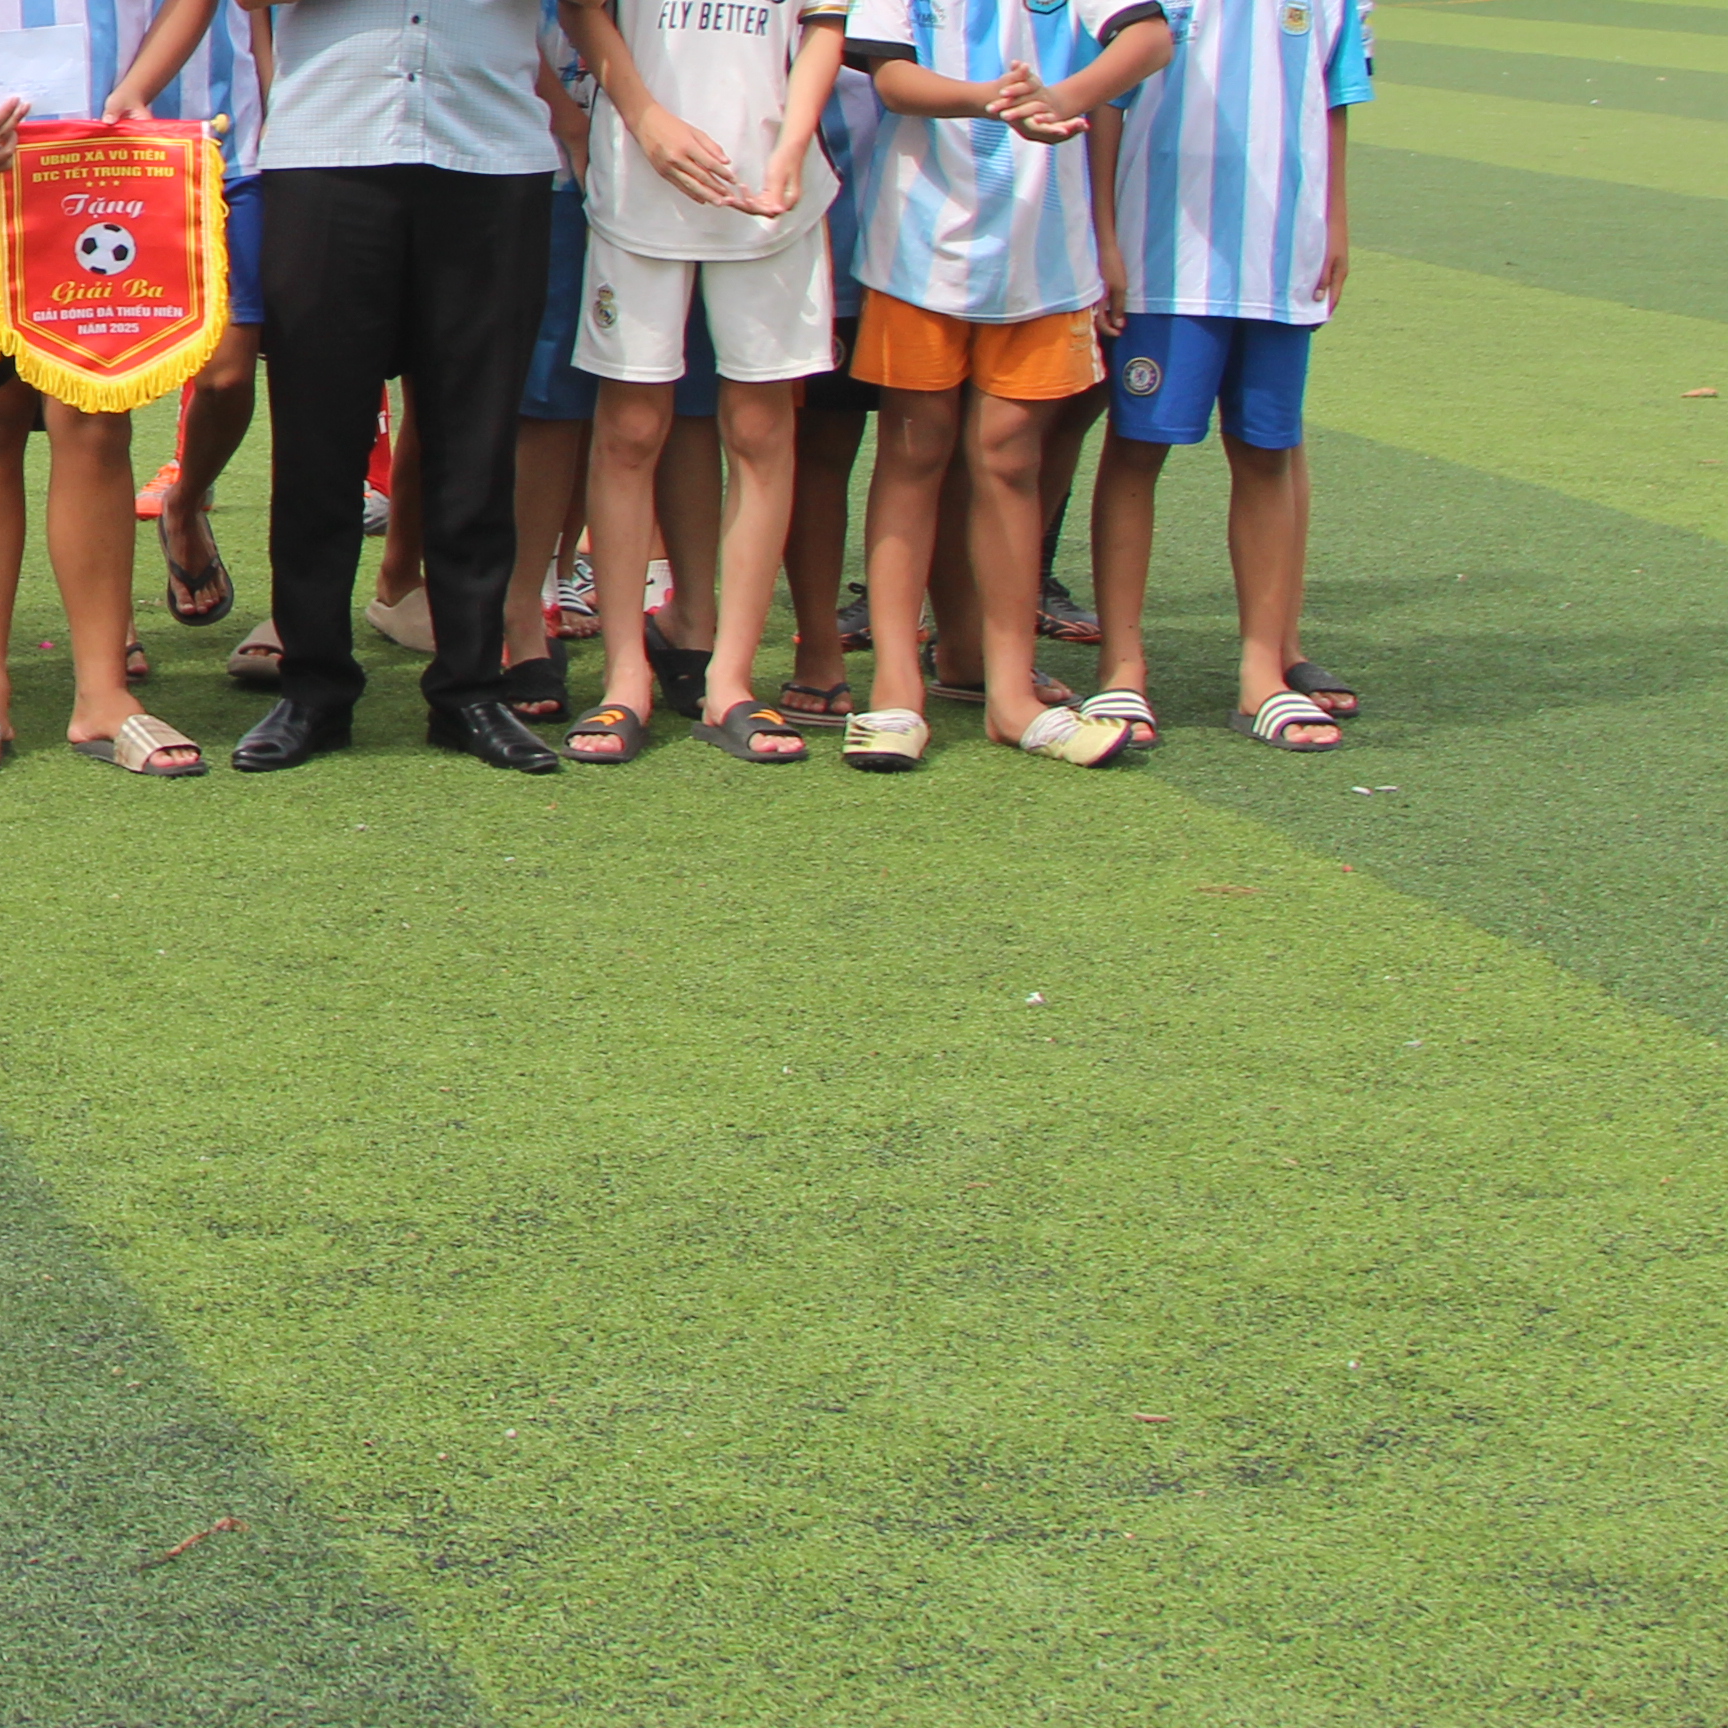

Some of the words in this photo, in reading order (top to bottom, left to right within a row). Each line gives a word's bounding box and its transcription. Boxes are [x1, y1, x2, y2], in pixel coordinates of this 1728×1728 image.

[658, 1, 693, 29] FLY
[697, 2, 769, 36] BETTER
[40, 153, 80, 166] UBND
[32, 171, 60, 182] BTC
[93, 167, 141, 177] TRUNG
[146, 167, 174, 177] THU
[61, 194, 144, 218] Tặng
[110, 323, 139, 333] 2025
